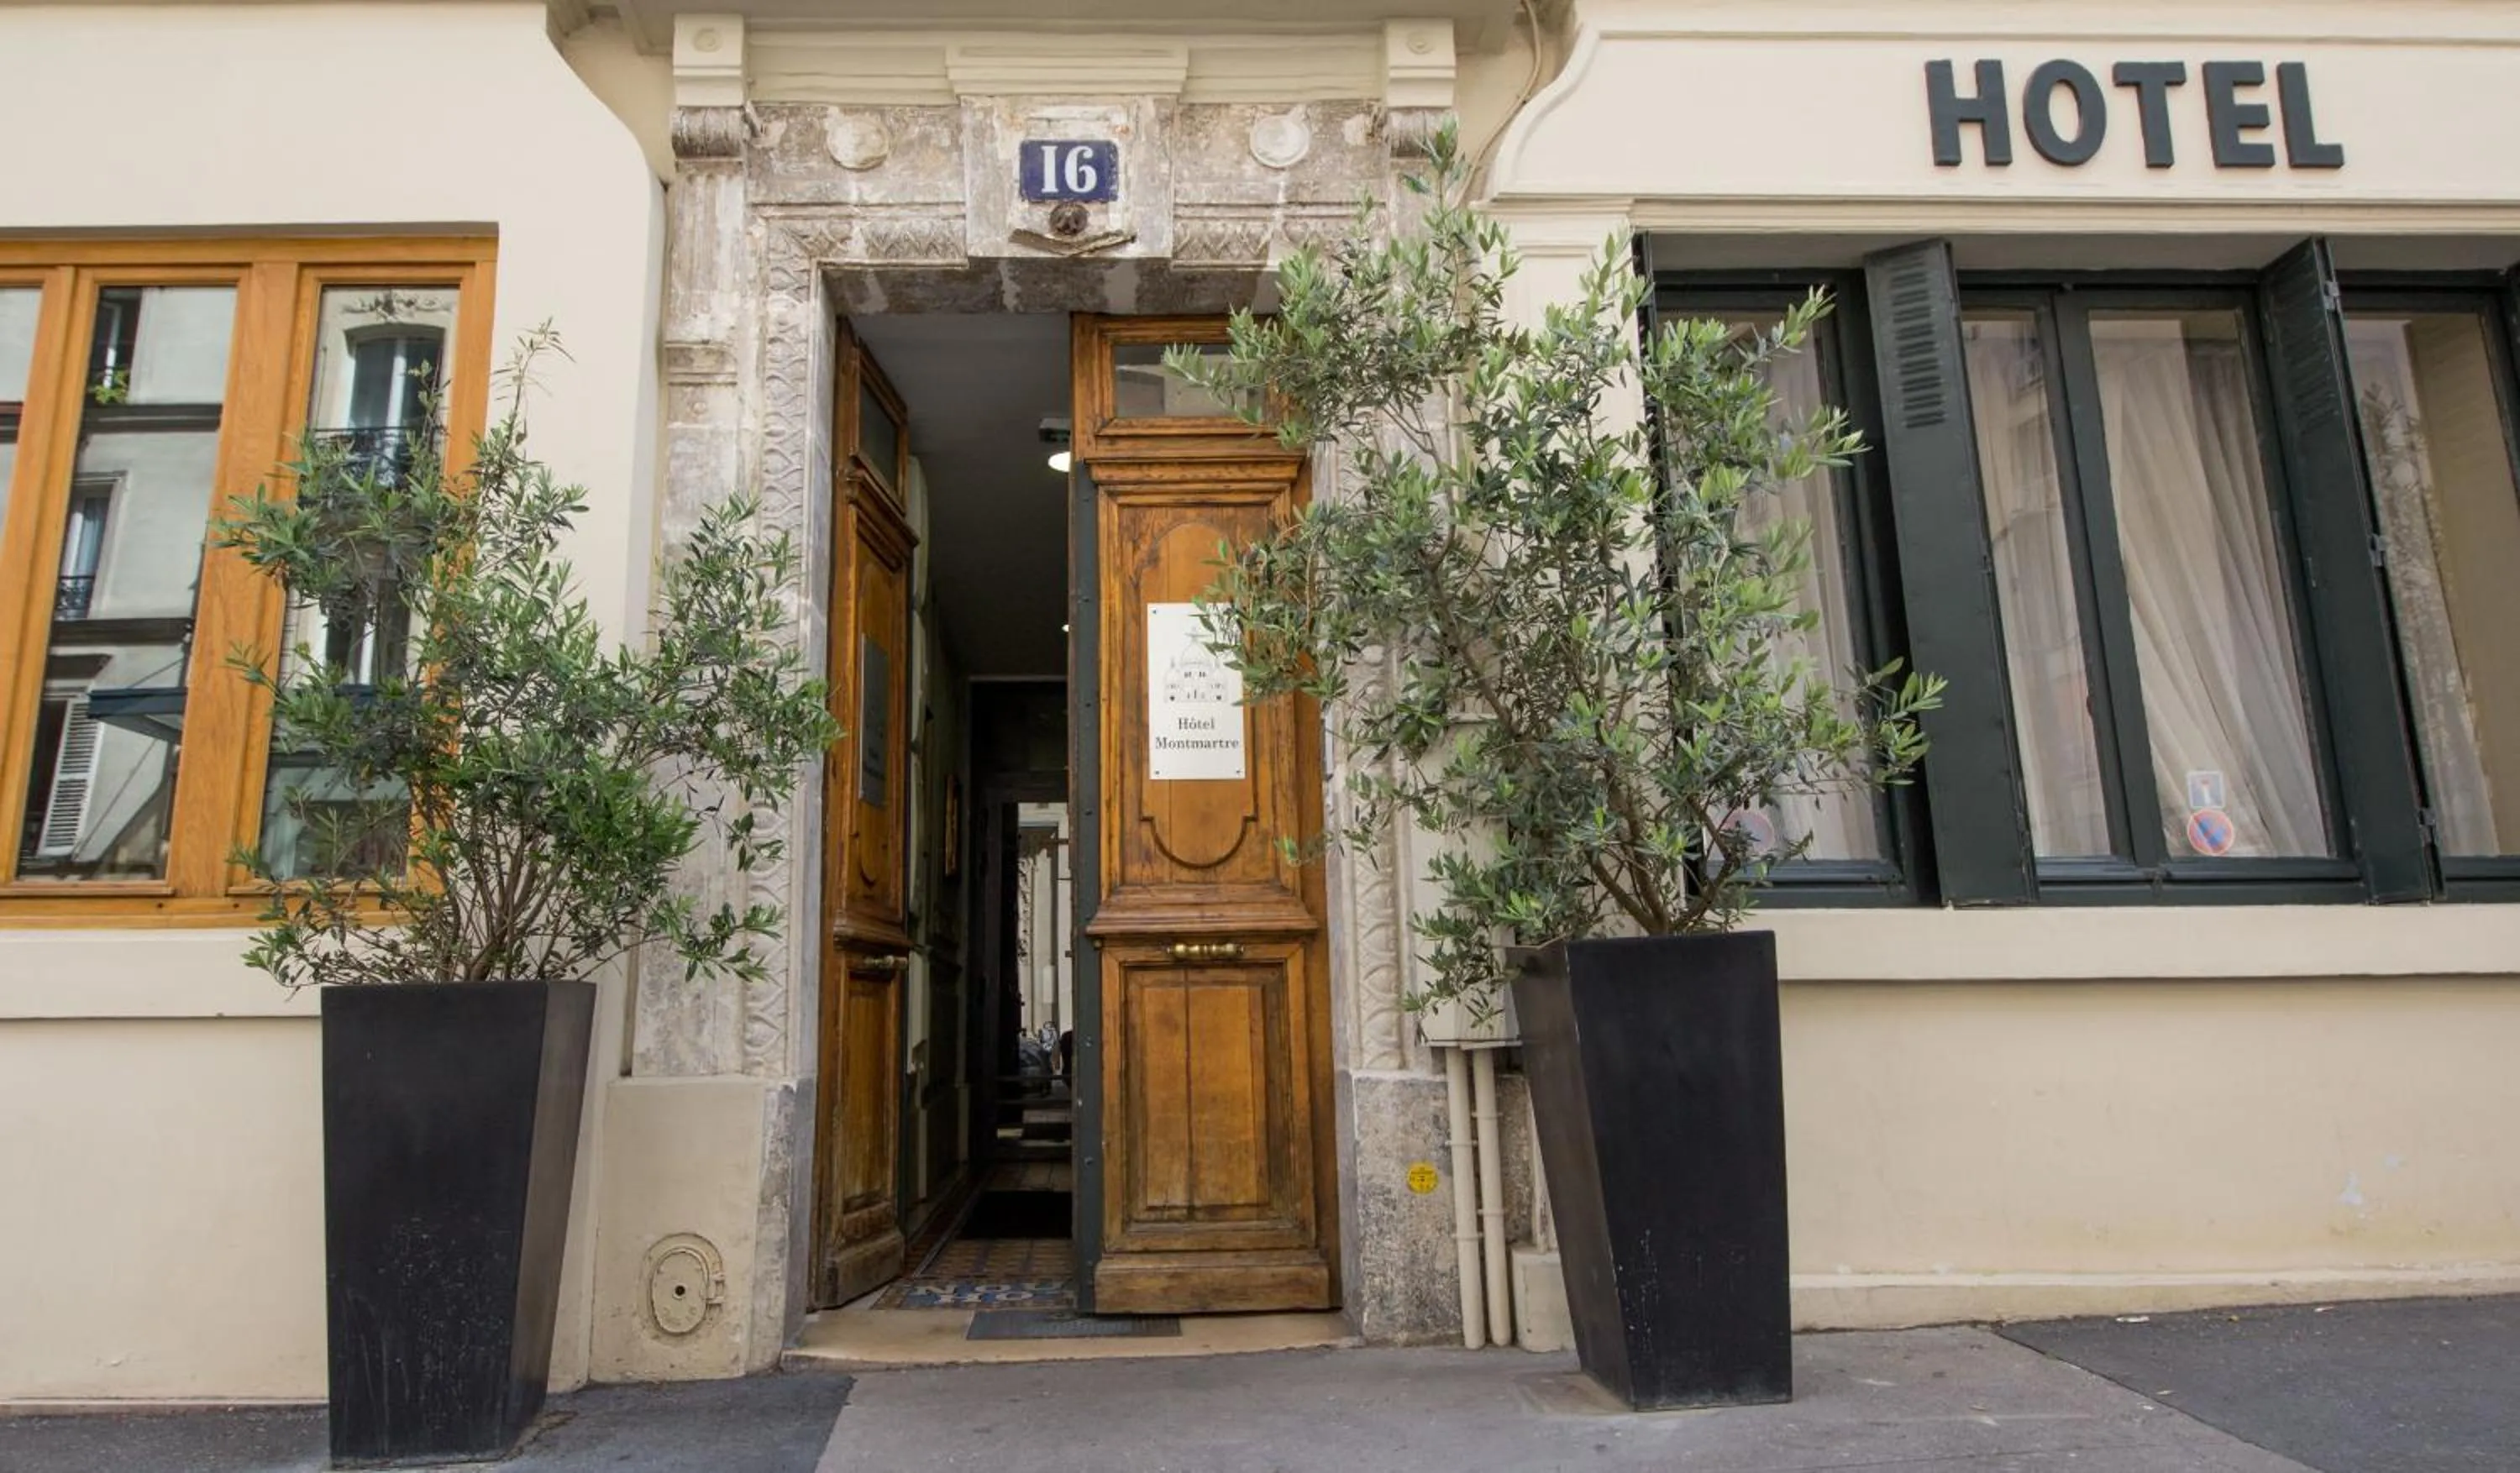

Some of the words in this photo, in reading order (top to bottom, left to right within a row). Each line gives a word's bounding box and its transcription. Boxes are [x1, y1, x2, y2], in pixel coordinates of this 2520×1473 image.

[1924, 59, 2344, 169] HOTEL
[1041, 145, 1097, 193] 16
[1179, 716, 1215, 730] Hôtel
[1155, 736, 1239, 750] Montmartre
